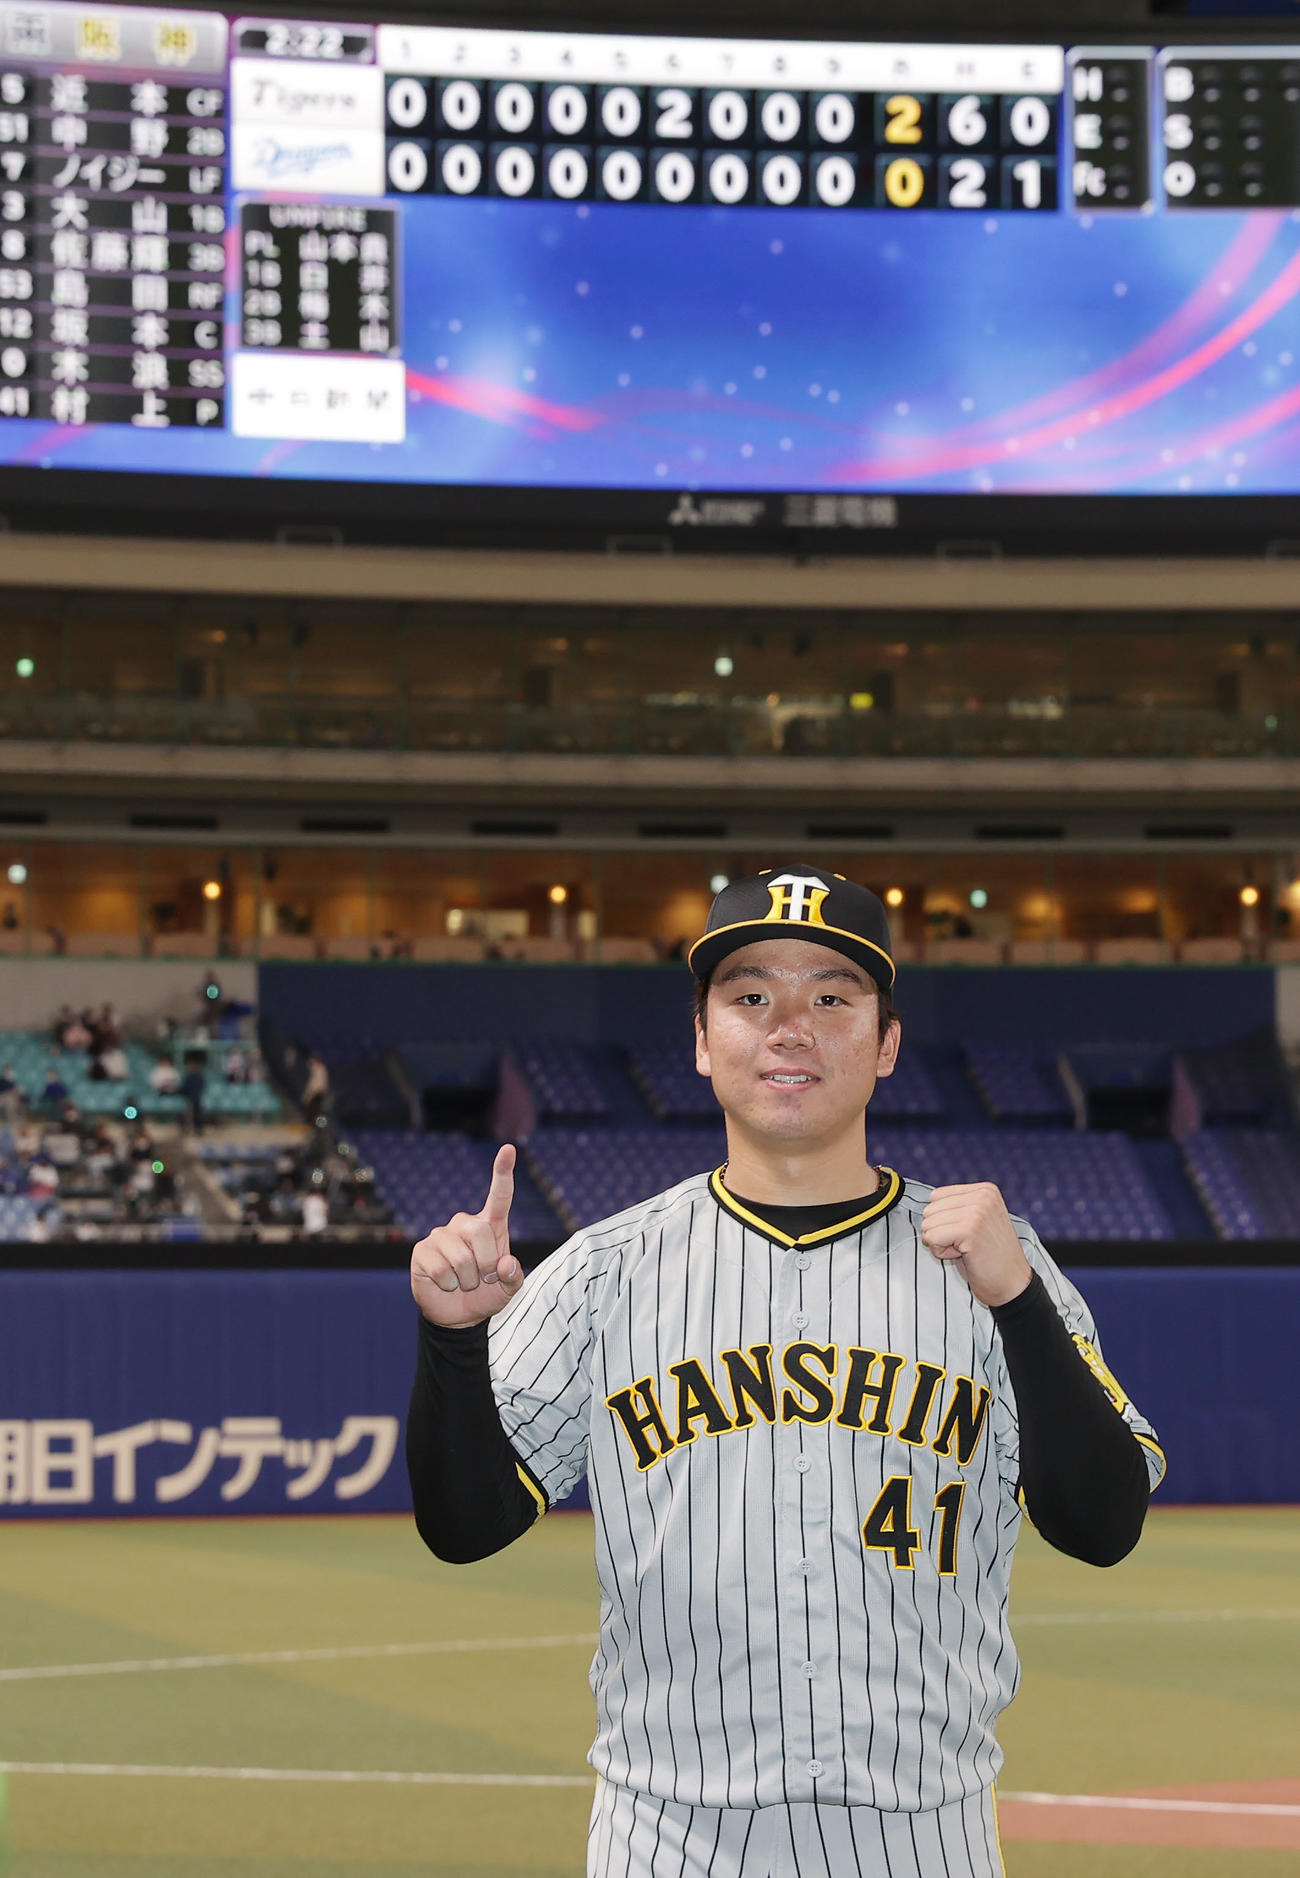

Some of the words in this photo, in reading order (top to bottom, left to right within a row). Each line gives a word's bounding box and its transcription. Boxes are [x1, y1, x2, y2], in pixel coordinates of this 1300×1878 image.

[1165, 68, 1194, 100] B
[388, 78, 427, 128] 0
[441, 80, 481, 130] 0
[495, 83, 534, 133] 0
[548, 85, 587, 135] 0
[602, 87, 641, 137] 0
[655, 89, 693, 138] 2
[709, 90, 748, 141] 0
[762, 92, 801, 141] 0
[815, 94, 854, 143] 0
[884, 96, 922, 144] 2
[948, 95, 986, 145] 6
[1011, 97, 1049, 146] 0
[1163, 114, 1193, 148] S
[52, 154, 166, 192] ノイジー
[388, 142, 427, 191] 0
[442, 144, 481, 194] 0
[495, 146, 534, 196] 0
[548, 149, 587, 198] 0
[602, 151, 641, 200] 0
[655, 152, 694, 202] 0
[709, 154, 748, 203] 0
[762, 155, 801, 205] 0
[816, 157, 855, 206] 0
[885, 158, 924, 207] 0
[948, 159, 986, 208] 2
[1014, 160, 1041, 208] 1
[2, 191, 25, 221] 3
[194, 320, 218, 349] C
[196, 398, 218, 425] P
[604, 1340, 993, 1472] HANSHIN
[862, 1475, 968, 1577] 41
